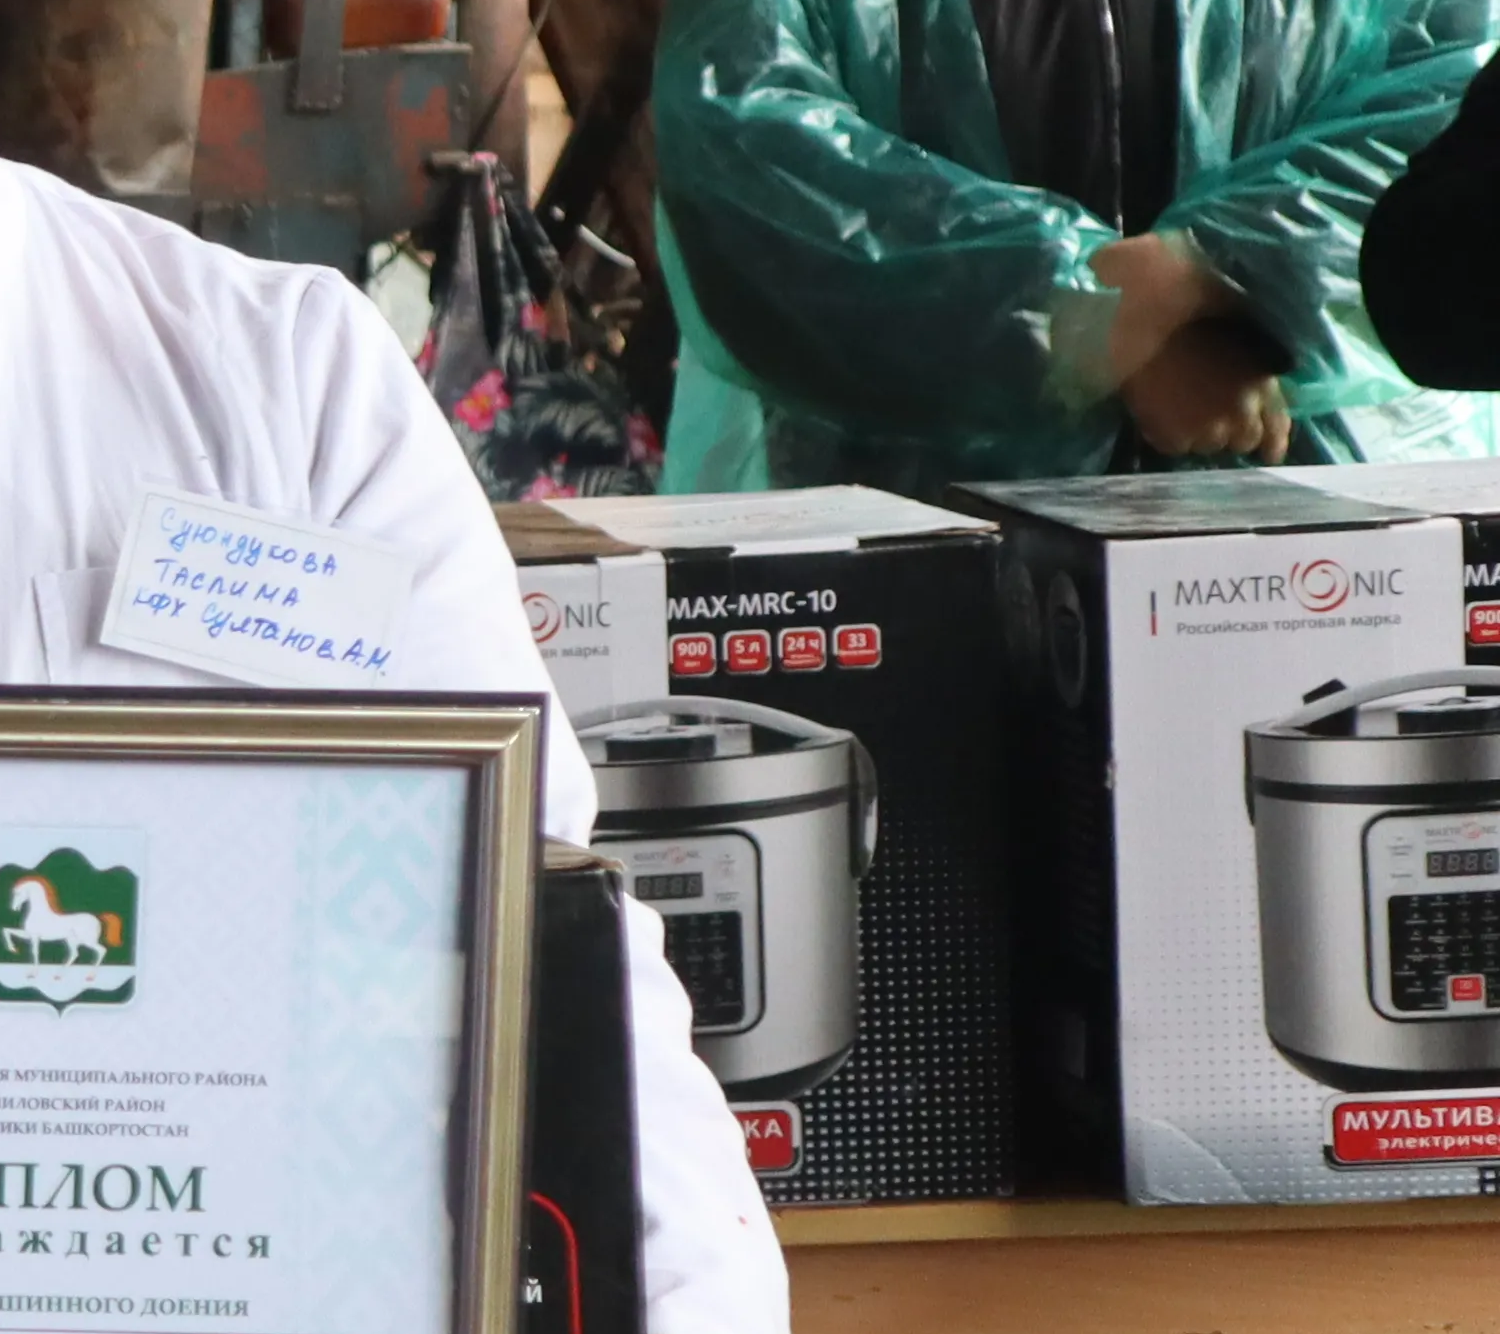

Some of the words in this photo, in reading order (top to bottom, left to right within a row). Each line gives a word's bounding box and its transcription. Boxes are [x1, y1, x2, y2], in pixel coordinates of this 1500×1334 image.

[1174, 560, 1405, 612] MAXTRONIC
[667, 589, 837, 620] MAX-MRC-10
[1177, 620, 1268, 635] Российская
[1274, 617, 1345, 632] торговая
[1351, 614, 1401, 626] марка
[677, 642, 706, 657] 900
[787, 636, 806, 650] 24
[847, 633, 867, 648] 33
[14, 1069, 190, 1088] МУНИЦИПАЛЬНОГО
[194, 1070, 268, 1087] РАЙОНА
[103, 1096, 165, 1113] РАЙОН
[1343, 1105, 1500, 1131] МУЛЬТИВ
[42, 1120, 189, 1138] БАШКОРТОСТАН
[1378, 1133, 1500, 1150] электриче
[141, 1297, 249, 1318] ДОЕНИЯ
